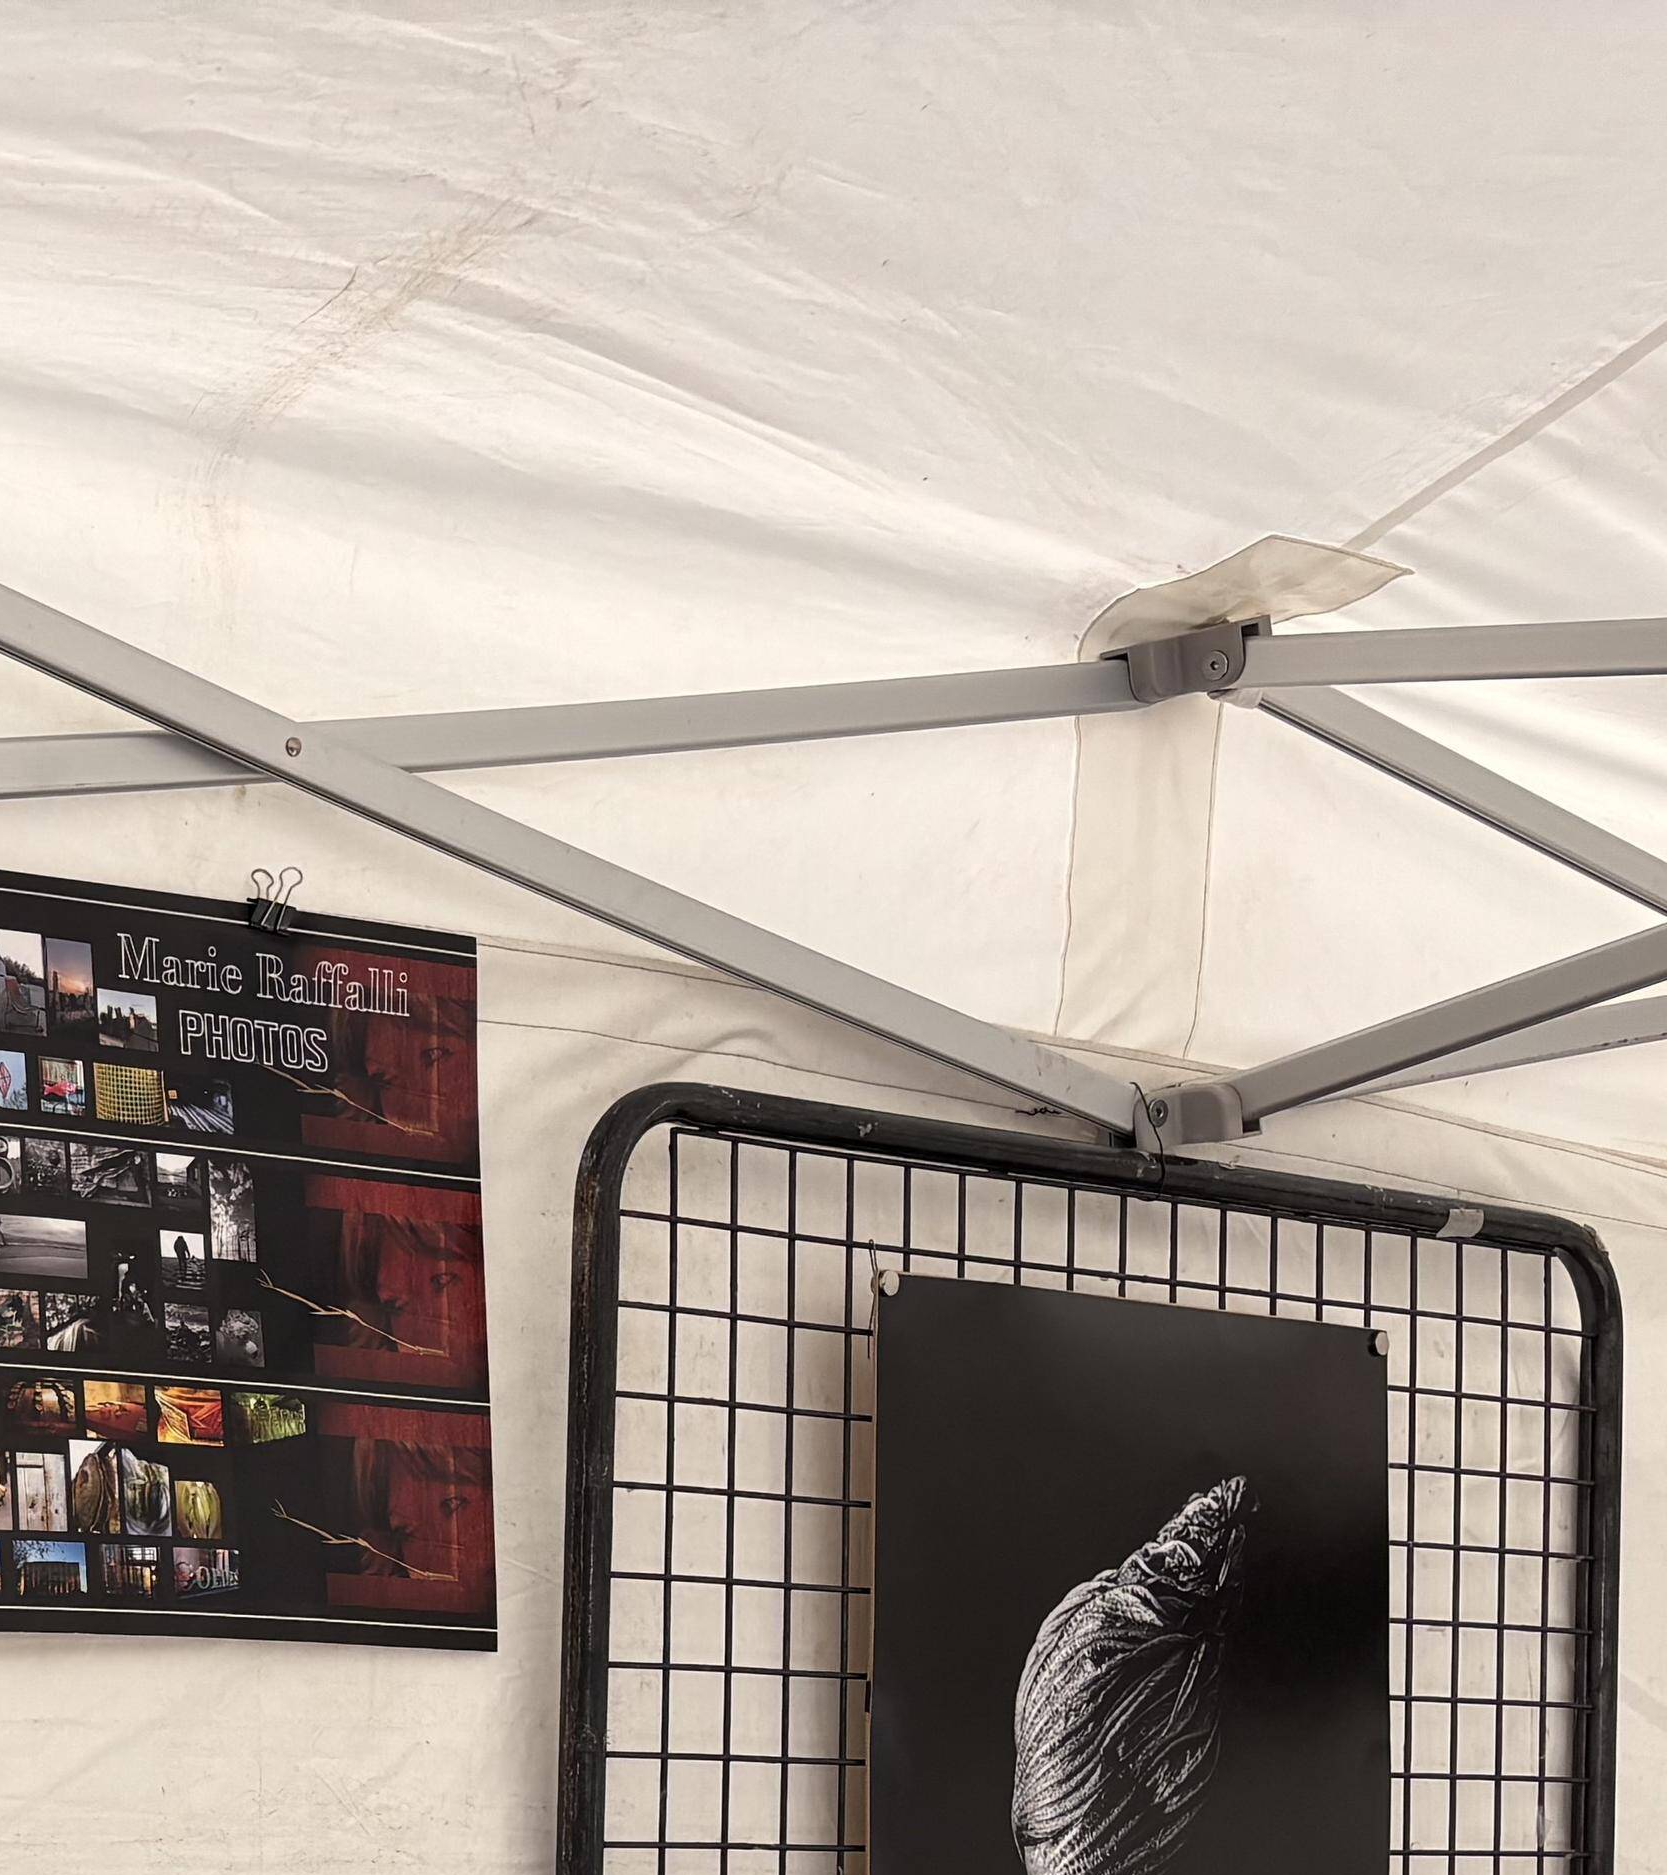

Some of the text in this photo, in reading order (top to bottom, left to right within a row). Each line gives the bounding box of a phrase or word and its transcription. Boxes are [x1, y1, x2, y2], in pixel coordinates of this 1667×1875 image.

[117, 932, 410, 1017] Marie Raffalli
[179, 1009, 328, 1073] PHOTOS
